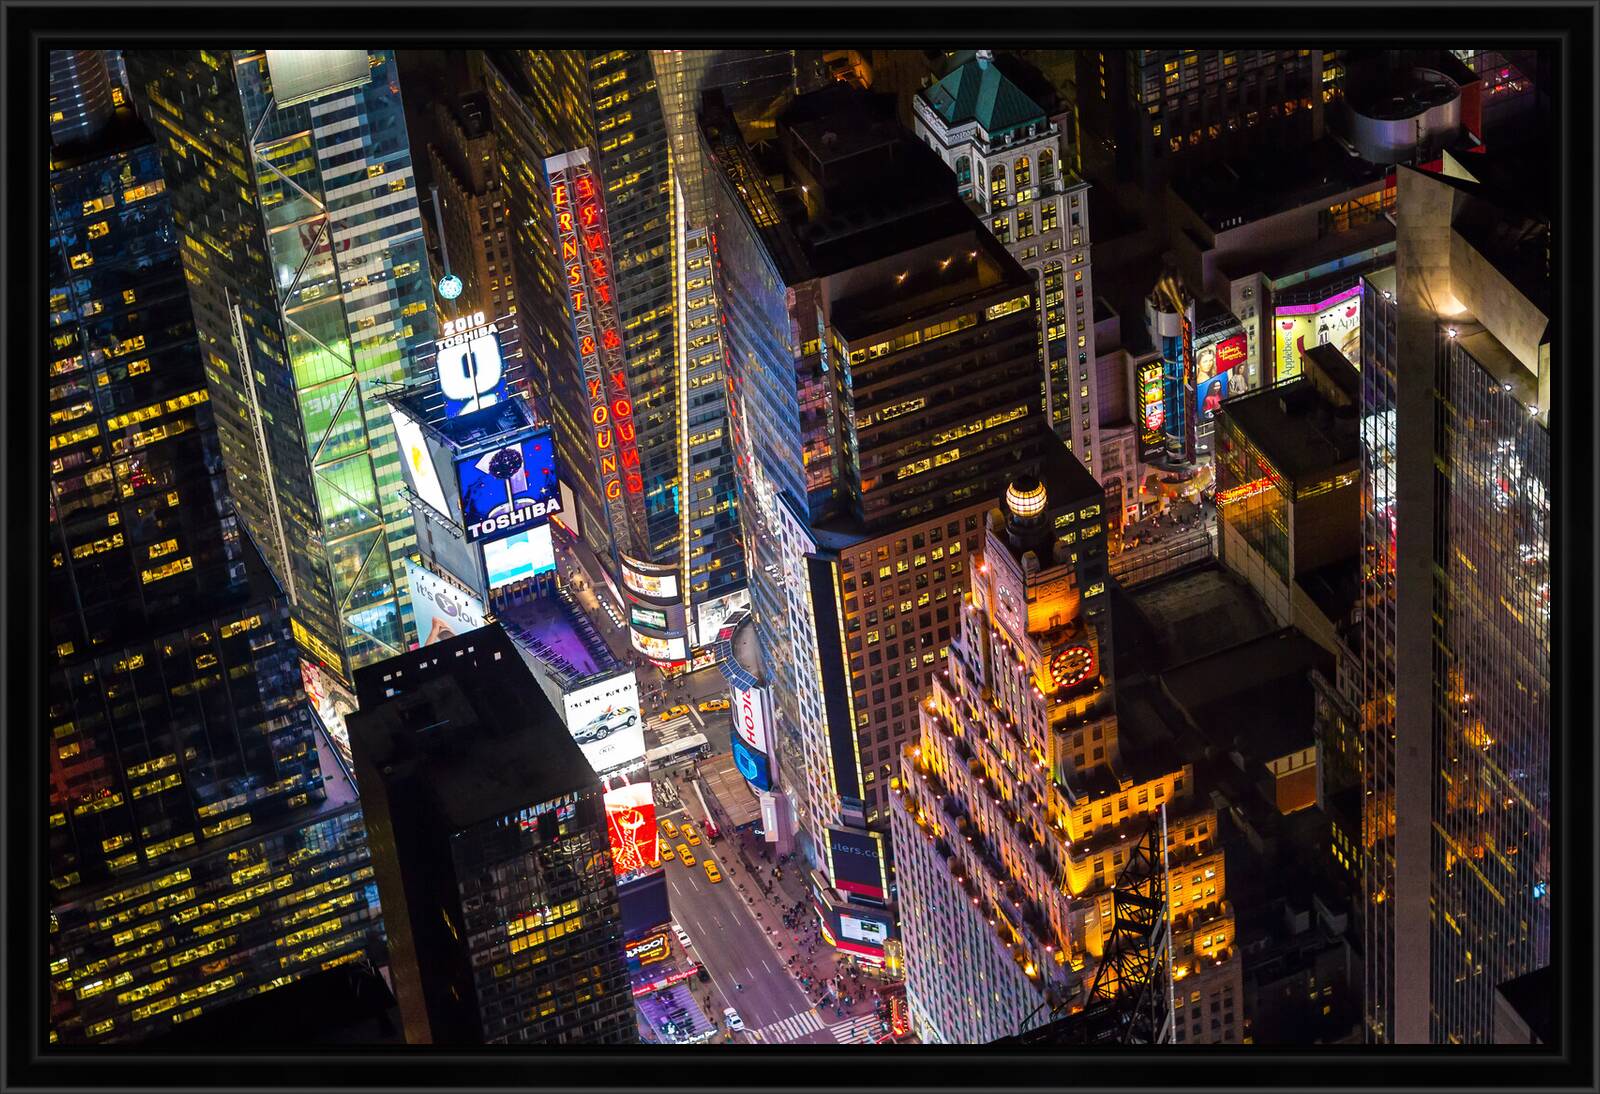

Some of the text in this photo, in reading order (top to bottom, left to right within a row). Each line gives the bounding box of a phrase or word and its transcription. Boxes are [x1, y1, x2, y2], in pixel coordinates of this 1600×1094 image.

[435, 323, 498, 350] TOSHIBA
[443, 311, 486, 336] 2010
[554, 184, 621, 498] ERNST & YOUNG
[467, 497, 561, 538] TOSHIBA
[416, 580, 434, 601] It's
[741, 687, 757, 745] RICOH
